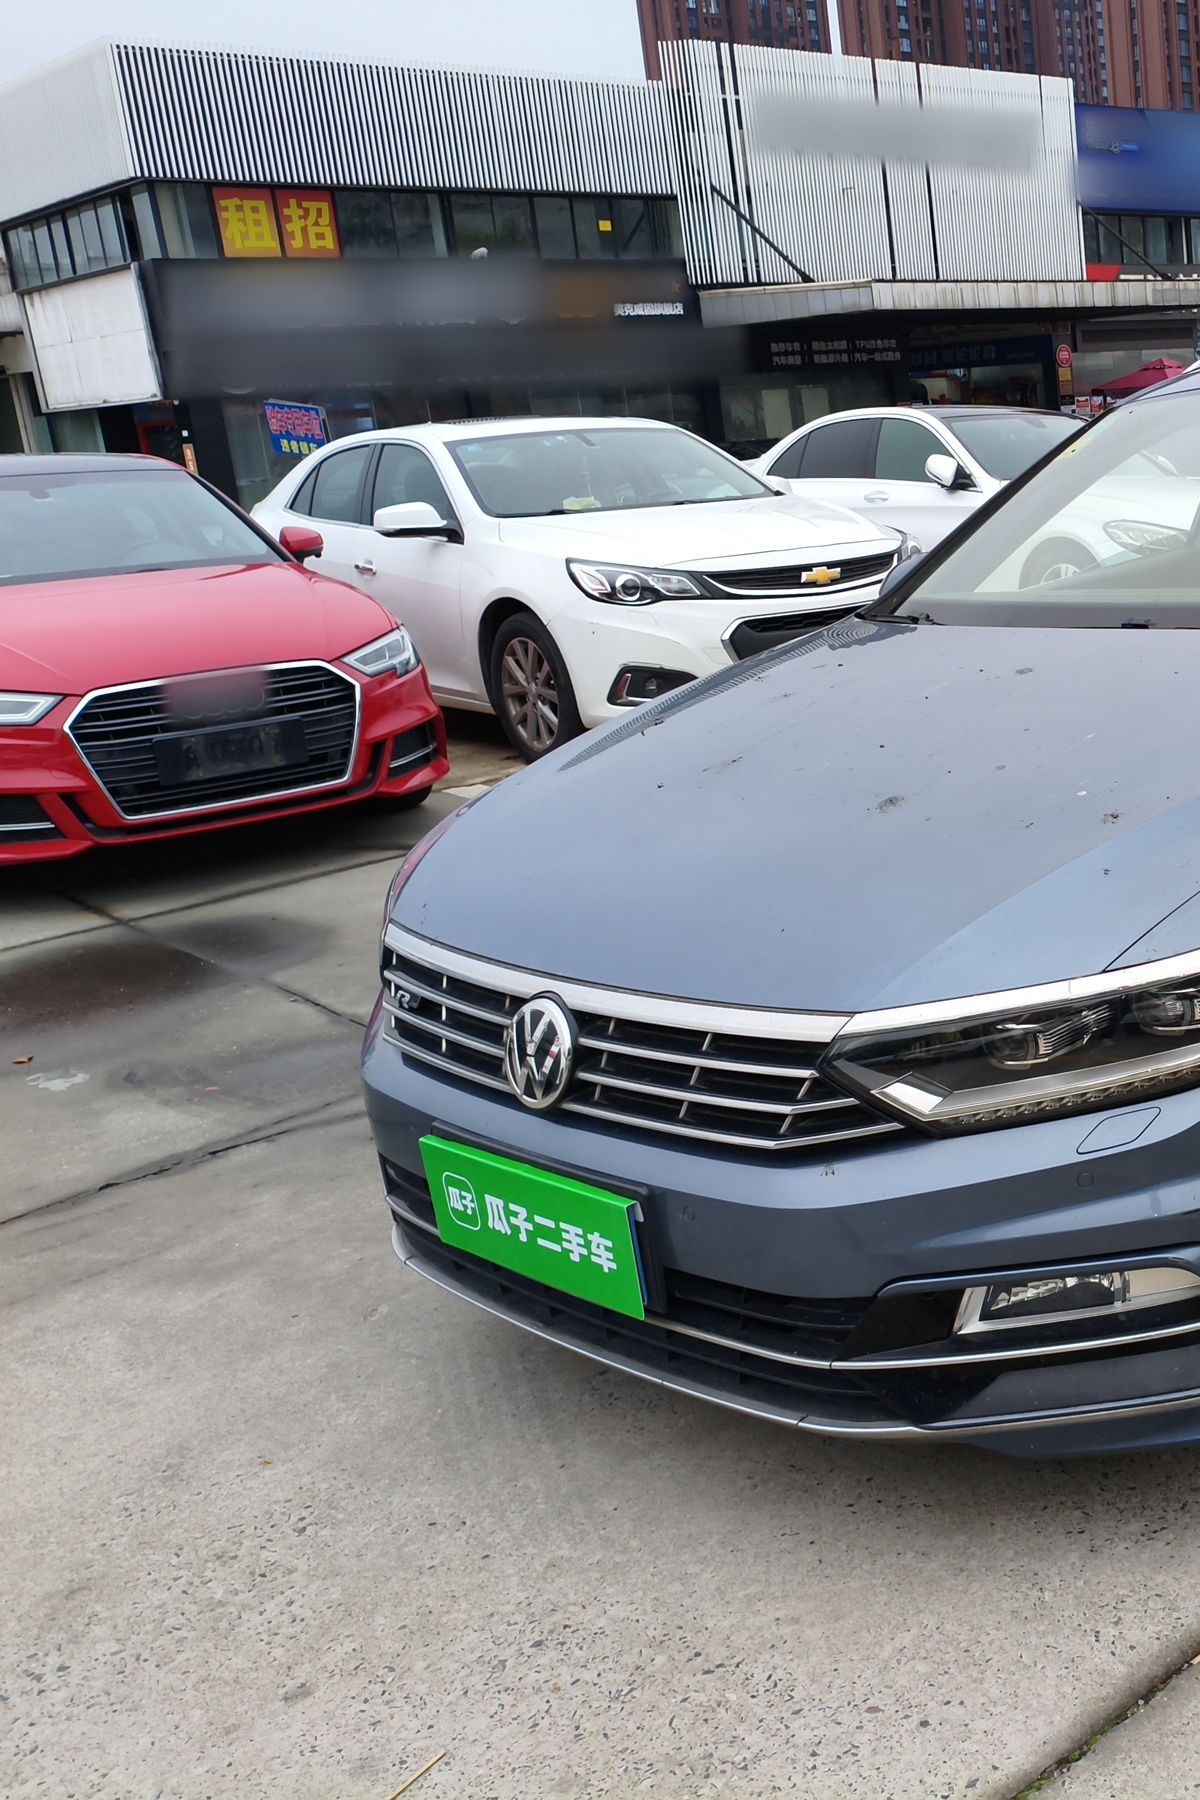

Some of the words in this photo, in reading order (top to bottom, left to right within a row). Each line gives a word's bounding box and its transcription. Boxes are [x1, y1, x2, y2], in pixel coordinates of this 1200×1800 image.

[447, 1185, 475, 1215] 瓜子
[484, 1193, 618, 1273] 瓜子二手车
